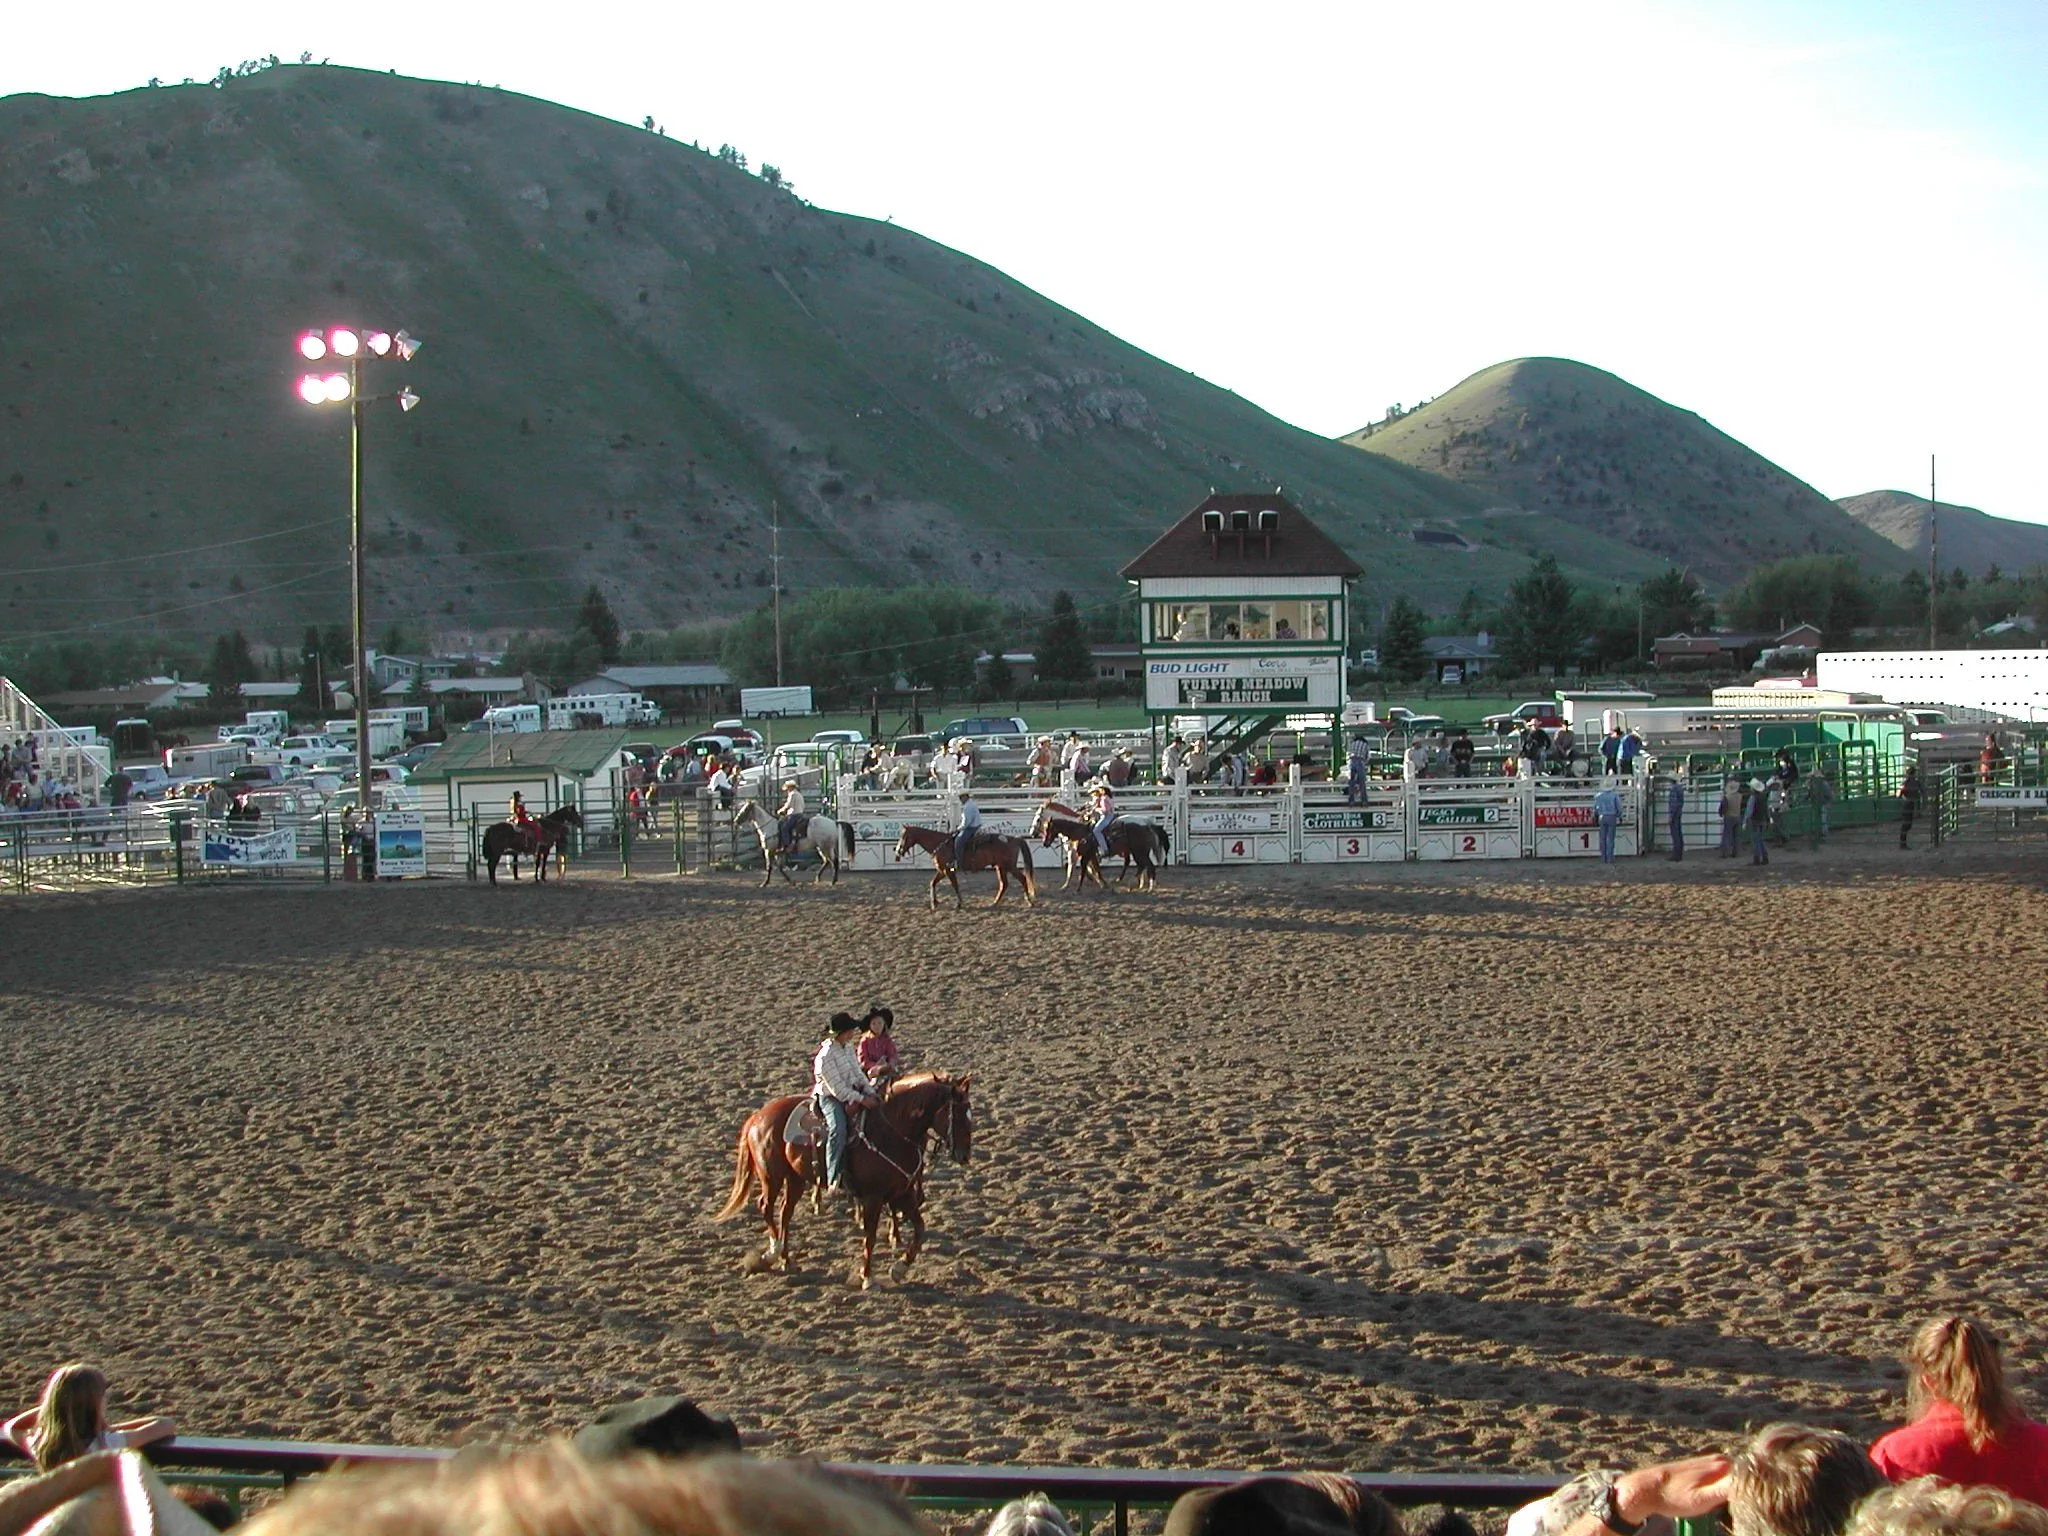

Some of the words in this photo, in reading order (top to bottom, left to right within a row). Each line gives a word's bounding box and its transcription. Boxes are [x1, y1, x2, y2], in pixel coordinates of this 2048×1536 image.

[1150, 663, 1182, 674] BUD
[1185, 662, 1230, 674] LIGHT
[1258, 658, 1288, 668] Coors
[1181, 678, 1238, 690] TURPIN
[1241, 677, 1306, 689] MEADOW
[1220, 690, 1272, 702] RANCH
[1487, 809, 1496, 821] 2
[1537, 807, 1575, 816] CORRAL
[1202, 812, 1258, 824] PUZZLEFACE
[1305, 817, 1364, 829] CLOTHIERS
[1375, 813, 1385, 826] 3
[1436, 815, 1480, 824] GALLERY
[1346, 839, 1360, 855] 3
[1462, 836, 1477, 852] 2
[1580, 833, 1590, 849] 1
[1231, 840, 1246, 856] 4
